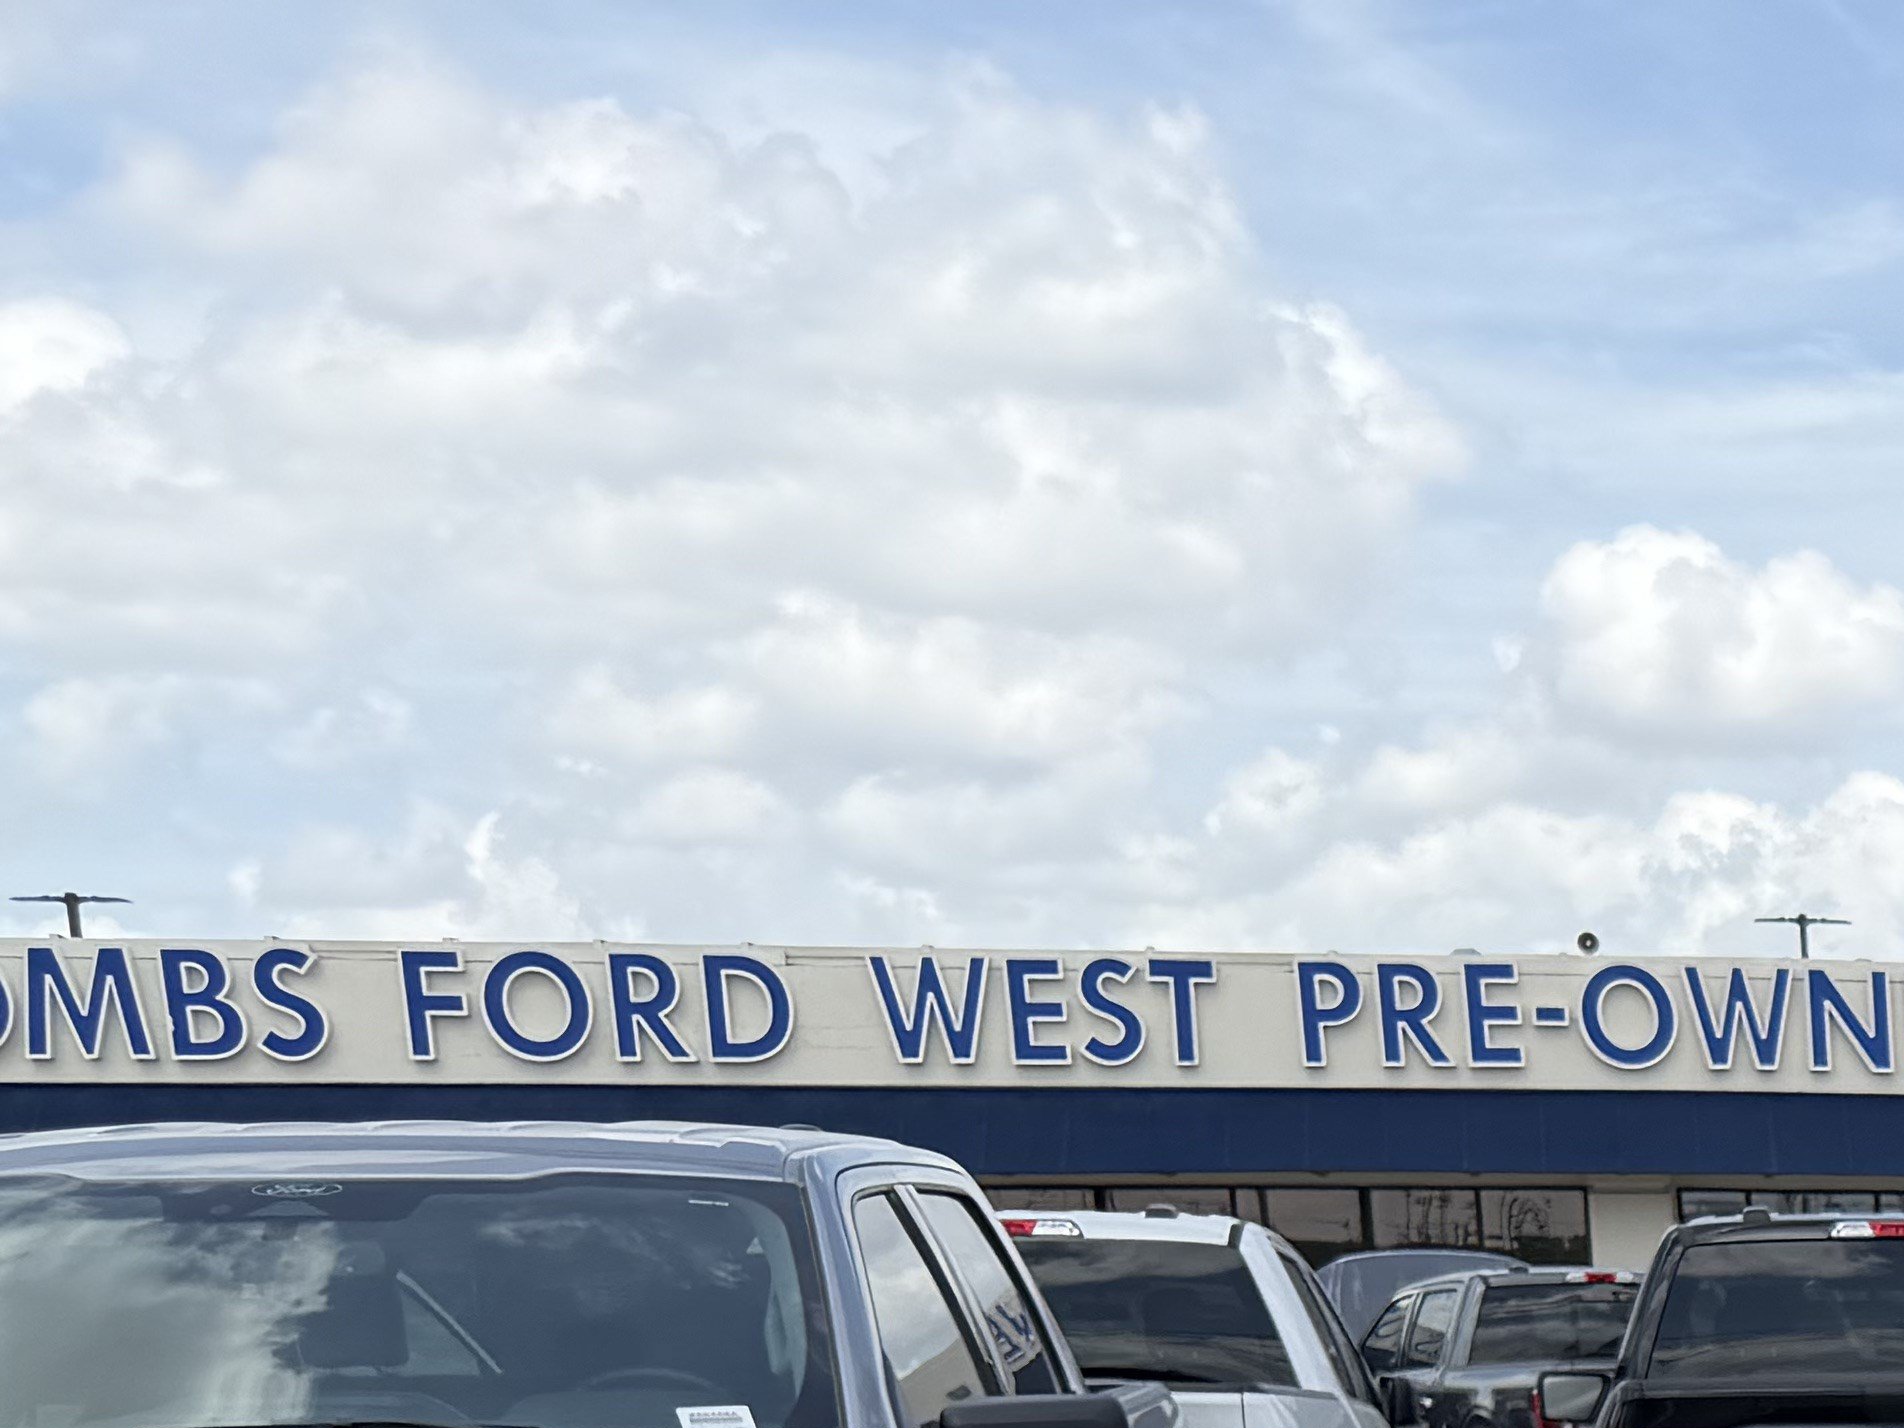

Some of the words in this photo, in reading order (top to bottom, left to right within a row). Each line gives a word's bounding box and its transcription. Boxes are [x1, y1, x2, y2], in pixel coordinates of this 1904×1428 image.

[0, 945, 331, 1063] MBS
[397, 949, 794, 1065] FORD
[866, 954, 1219, 1067] WEST
